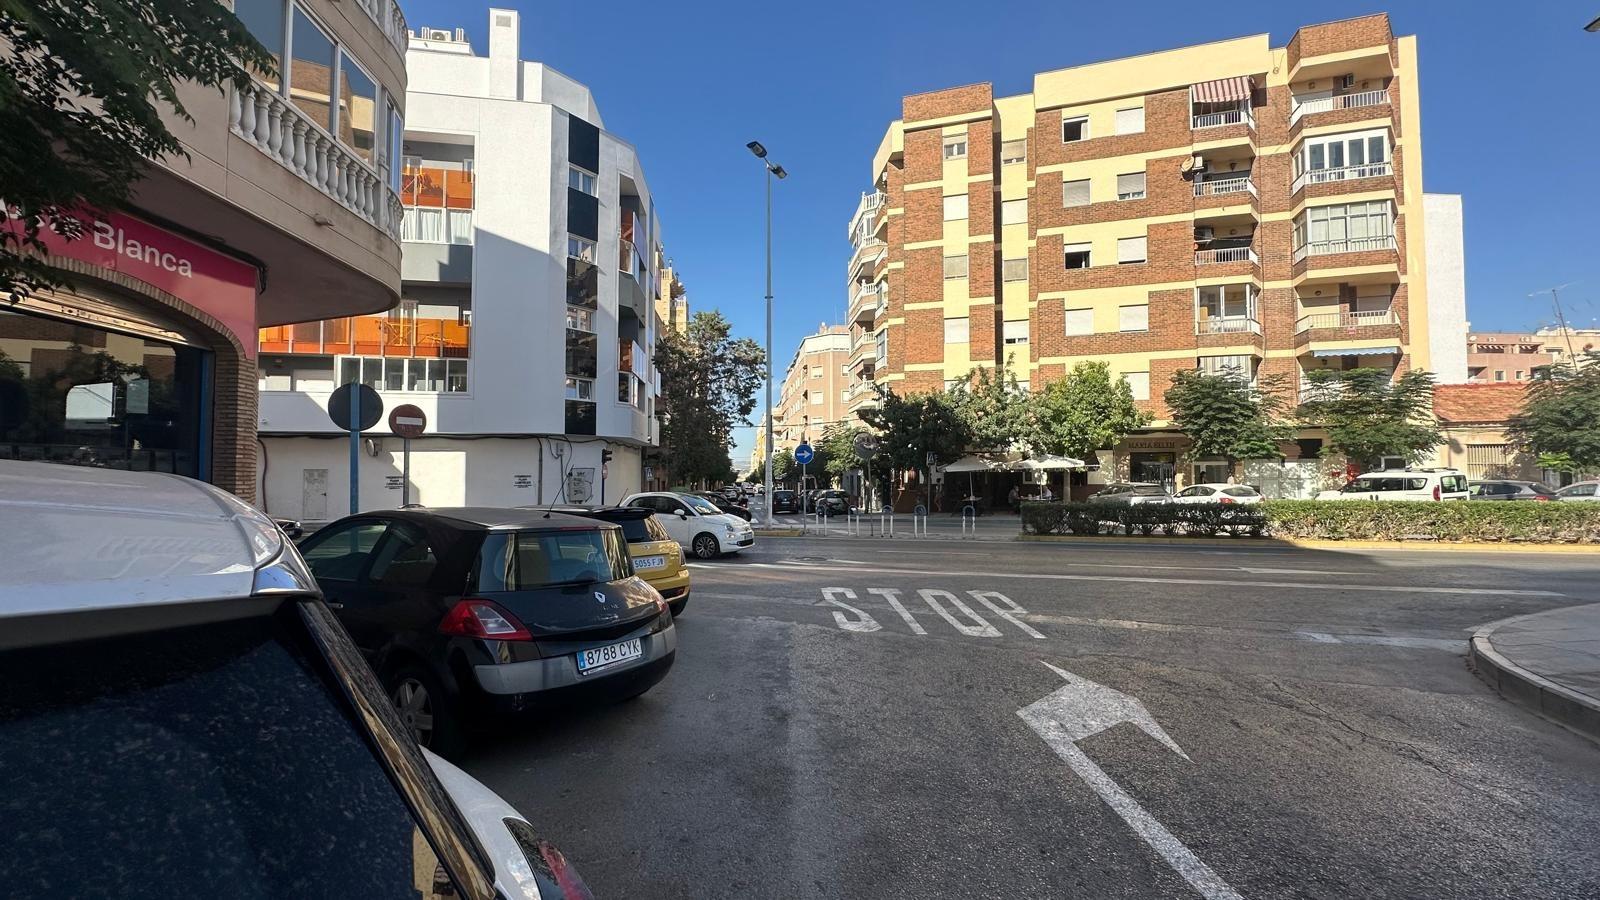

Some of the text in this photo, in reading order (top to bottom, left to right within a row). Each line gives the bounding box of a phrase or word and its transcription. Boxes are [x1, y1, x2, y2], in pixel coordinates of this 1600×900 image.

[93, 220, 192, 278] Blanca
[634, 559, 652, 568] 5055
[820, 586, 1048, 639] STOP
[586, 639, 640, 665] 8788 CYK
